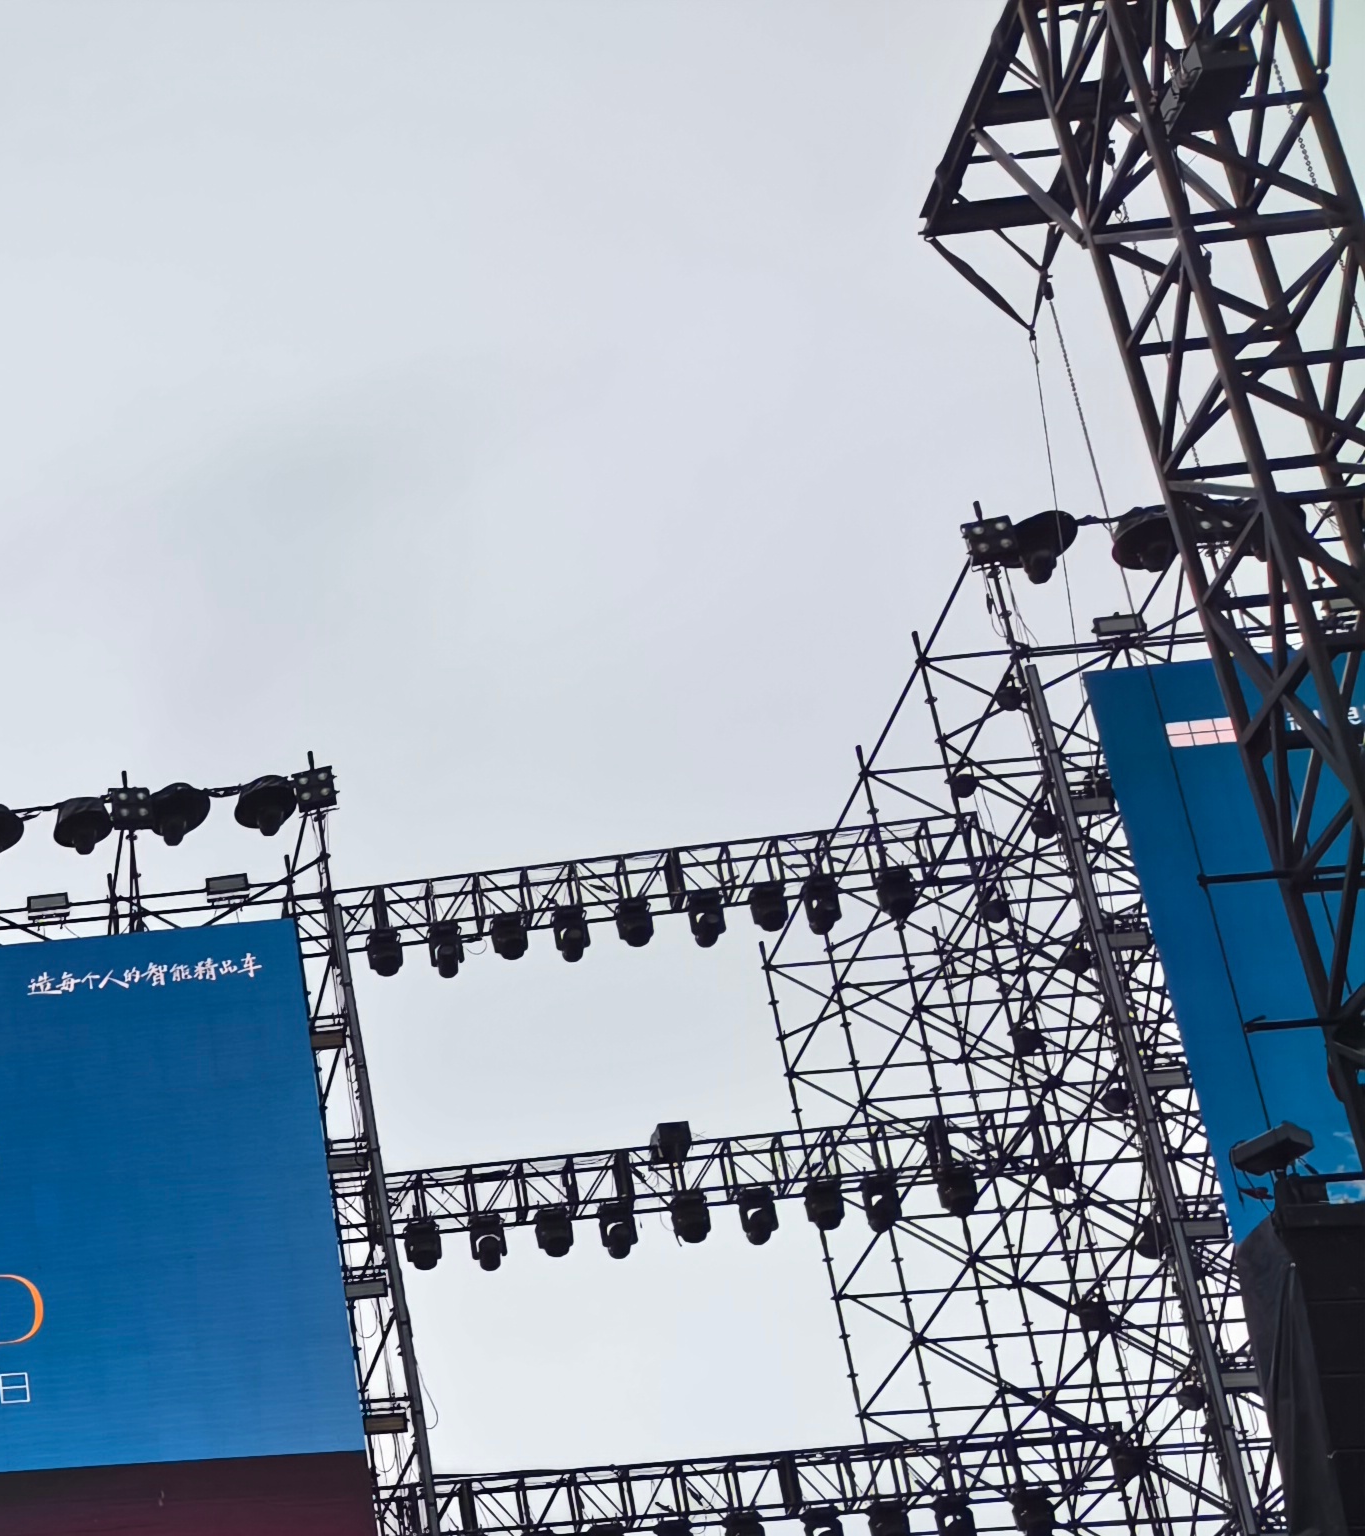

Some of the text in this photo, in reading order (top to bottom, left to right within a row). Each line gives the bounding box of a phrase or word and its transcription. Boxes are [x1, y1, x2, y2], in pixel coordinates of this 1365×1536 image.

[27, 952, 263, 996] 造每个人的智能精品车
